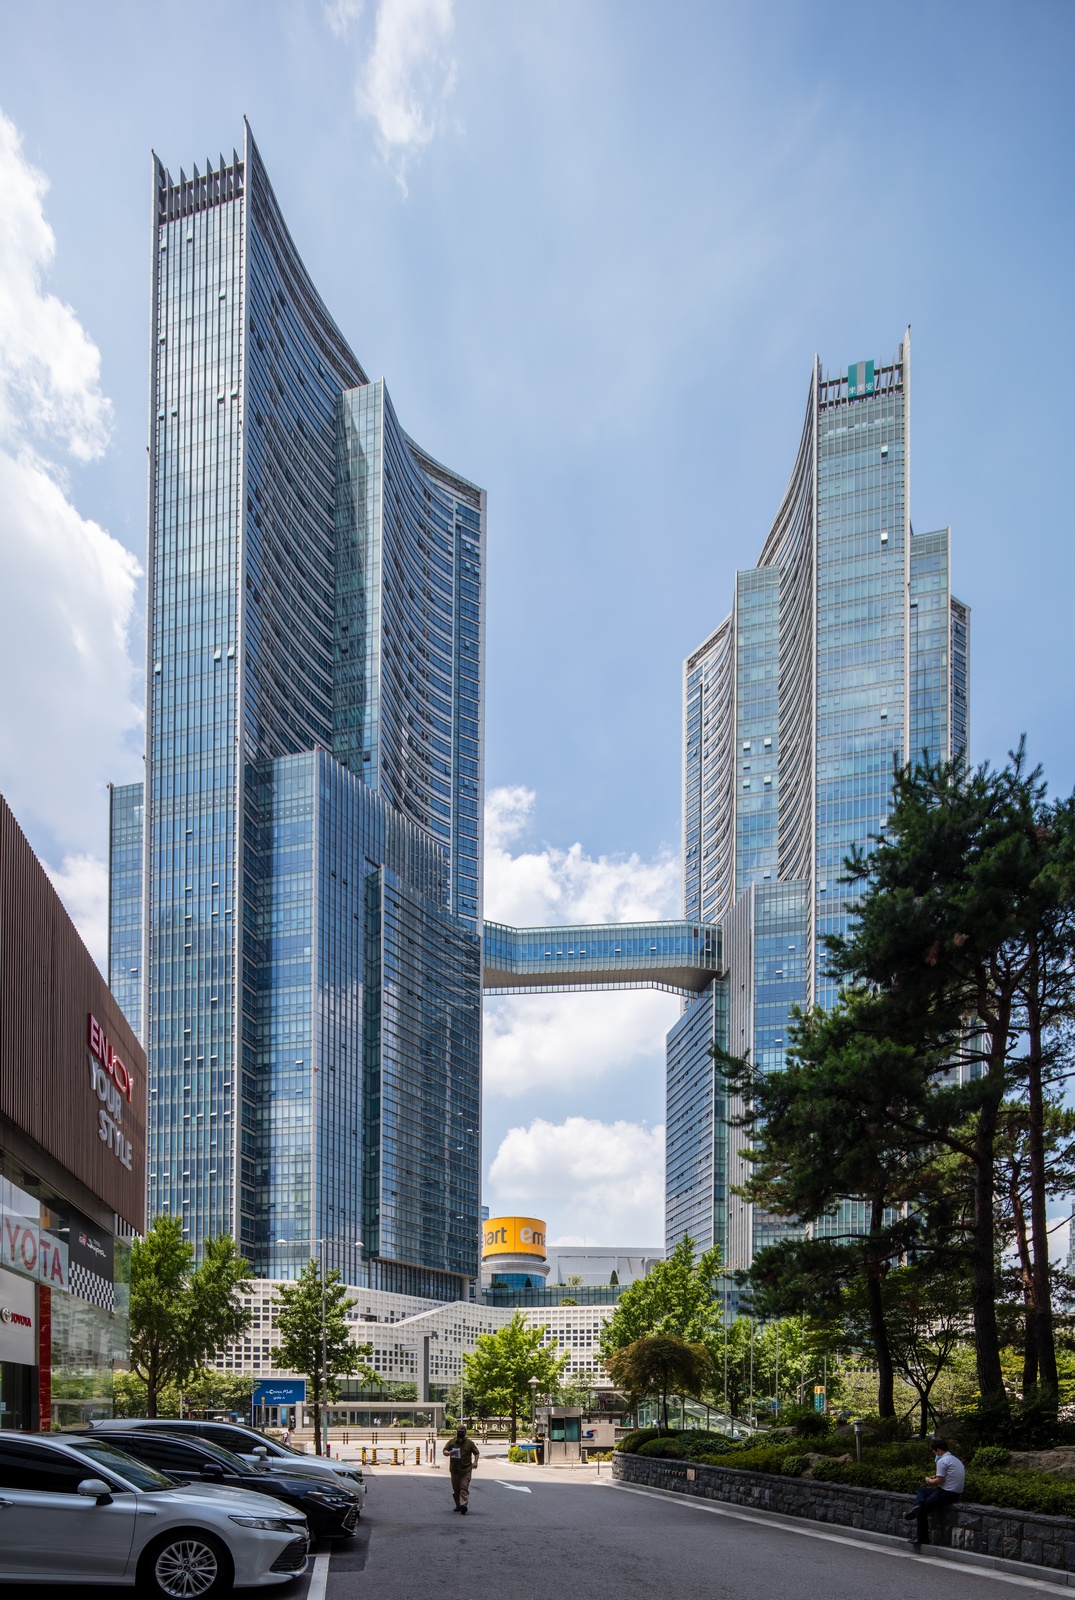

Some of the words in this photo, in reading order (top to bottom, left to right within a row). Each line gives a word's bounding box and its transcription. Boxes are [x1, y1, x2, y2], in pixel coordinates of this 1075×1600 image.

[88, 1013, 134, 1103] ENJOY
[88, 1053, 122, 1124] YOUR
[98, 1109, 132, 1171] STYLE
[0, 1216, 64, 1285] YOTA
[11, 1312, 32, 1327] TOYOTA
